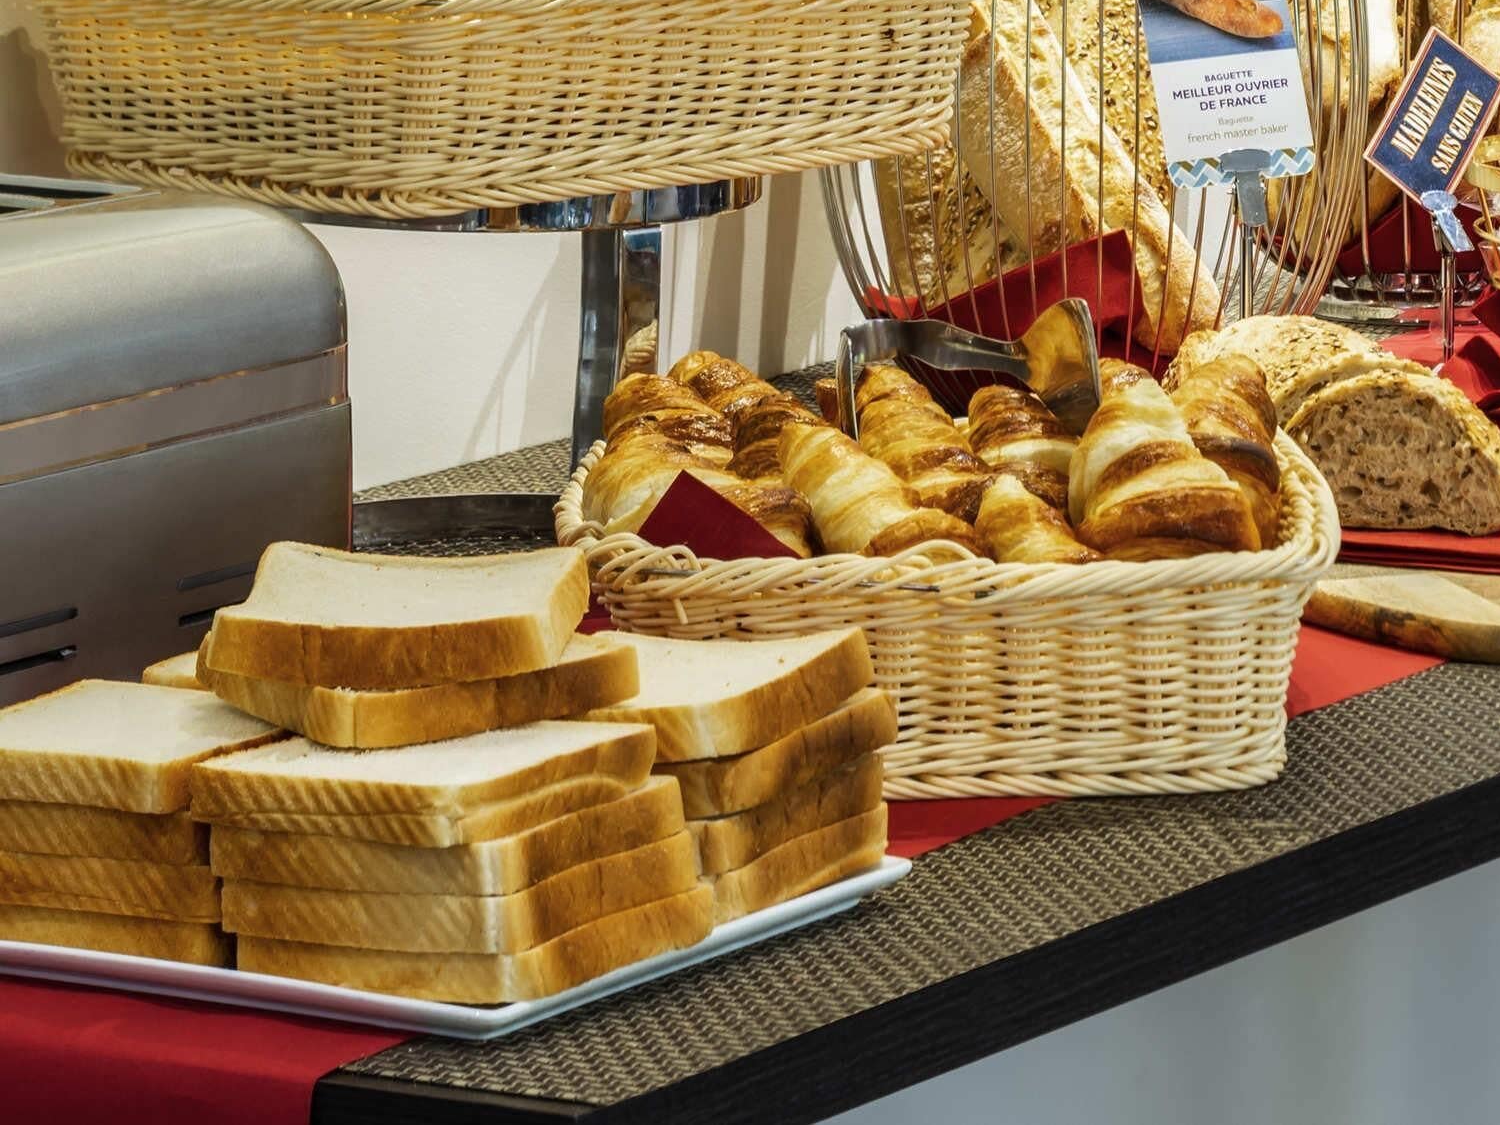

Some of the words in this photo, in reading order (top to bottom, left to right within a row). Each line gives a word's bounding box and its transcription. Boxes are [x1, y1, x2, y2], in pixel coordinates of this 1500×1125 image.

[1204, 70, 1253, 83] BAGUETTE
[1172, 84, 1232, 100] MEILLEUR
[1235, 78, 1289, 93] OUVRIER
[1199, 100, 1217, 111] DE
[1219, 94, 1267, 109] FRANCE
[1390, 56, 1457, 161] MADELEINES
[1218, 115, 1255, 127] Baguette
[1187, 131, 1221, 143] french
[1223, 128, 1258, 140] master
[1260, 123, 1289, 135] baker
[1431, 132, 1462, 176] SANS
[1449, 89, 1484, 141] GLUTEN
